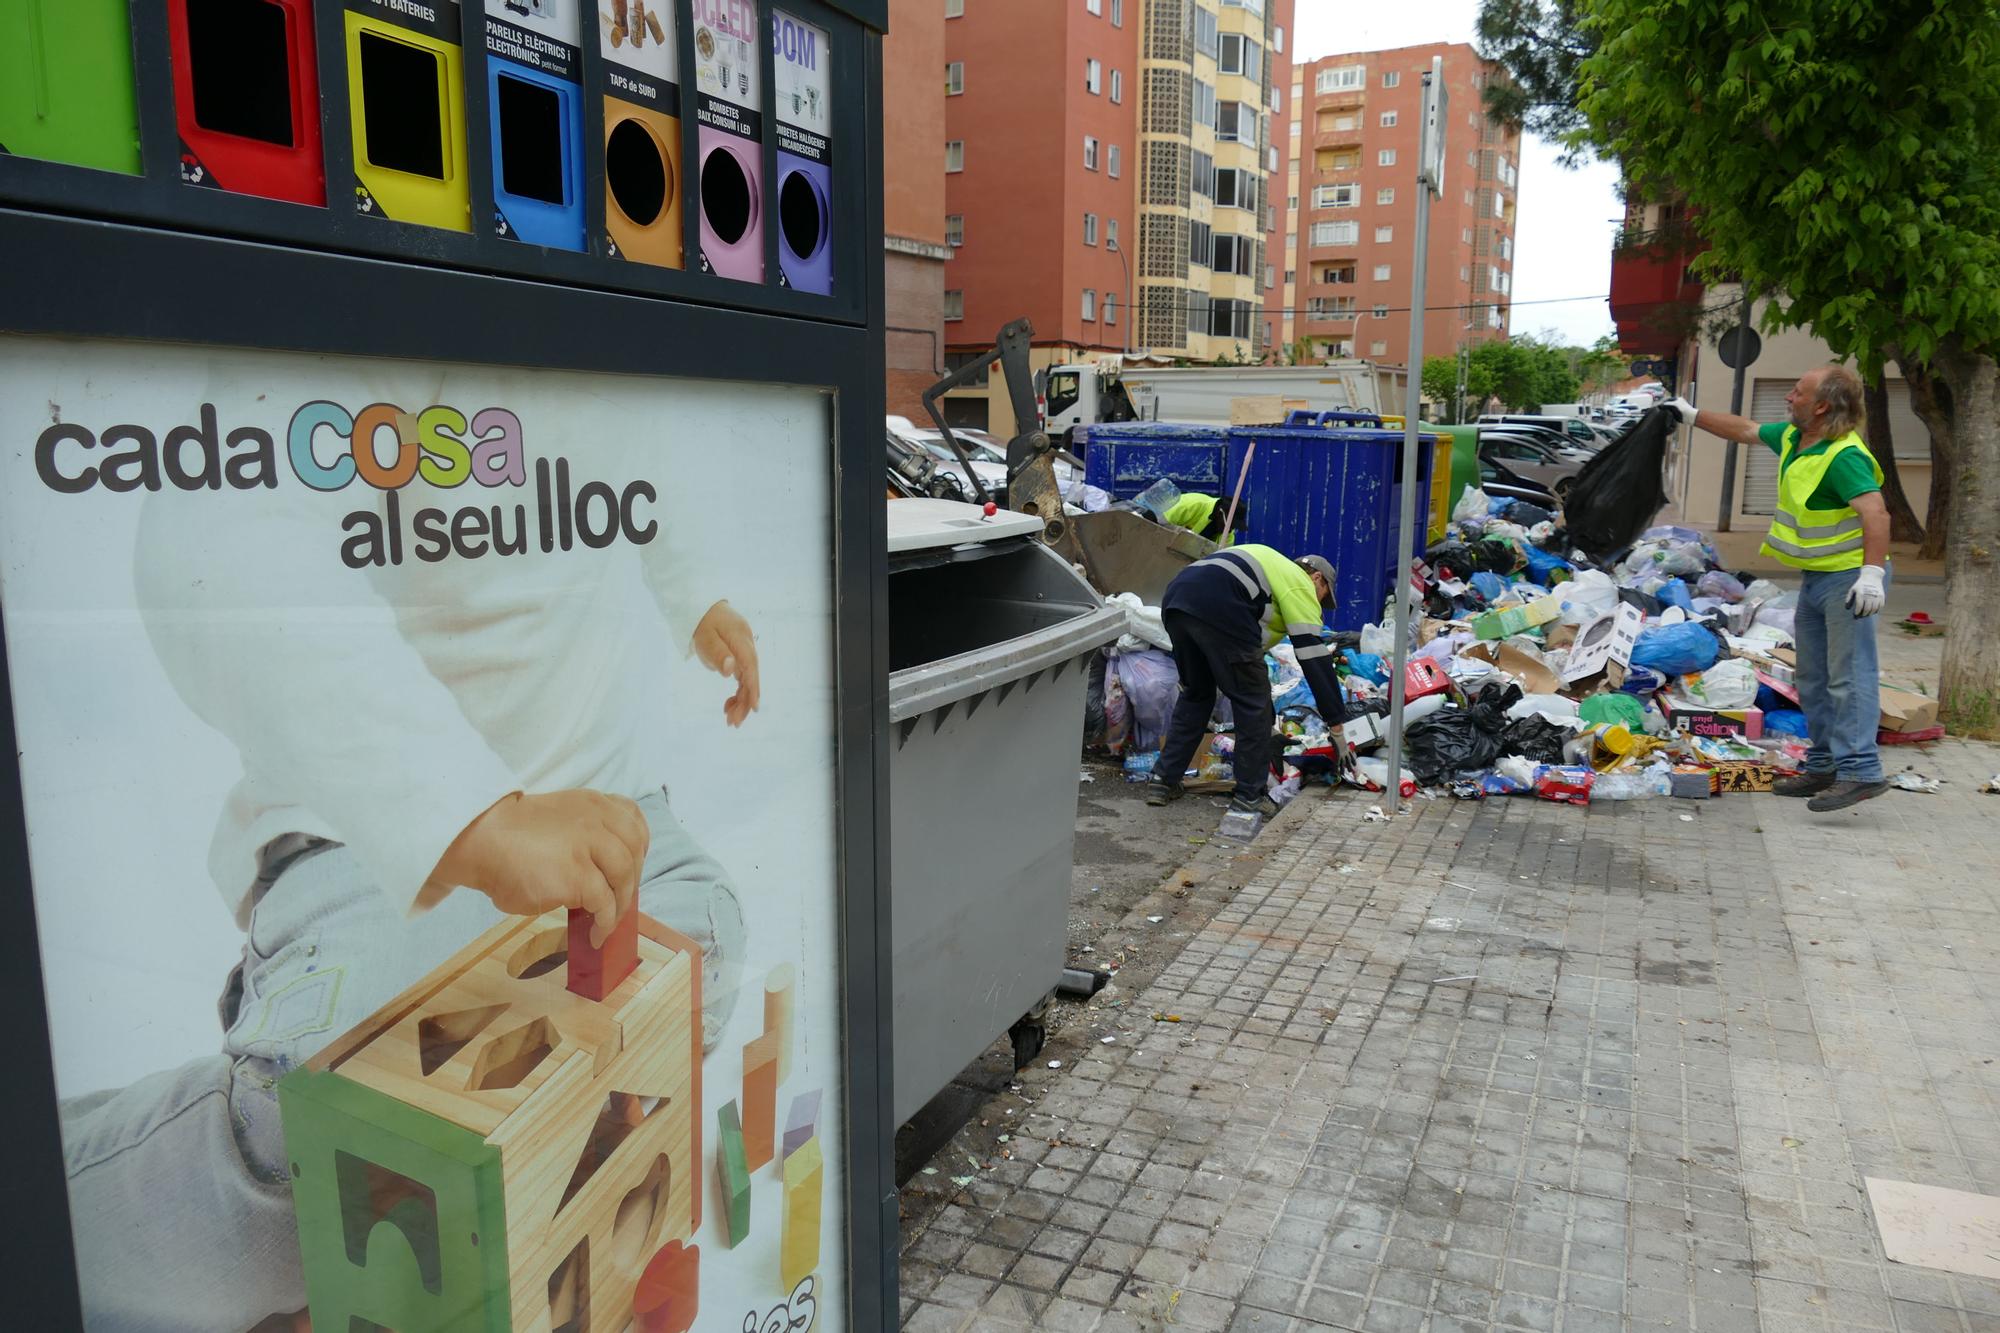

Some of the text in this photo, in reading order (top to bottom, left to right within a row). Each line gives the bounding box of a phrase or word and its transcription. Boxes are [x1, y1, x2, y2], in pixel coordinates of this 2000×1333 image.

[390, 0, 435, 22] BATERIES
[486, 20, 522, 44] PARELLS
[524, 35, 566, 60] ELÈCTRICS
[486, 36, 567, 75] ELECTRÒNICS petit format
[610, 72, 656, 99] TAPS de SURO
[708, 100, 739, 119] BOMBETES
[712, 114, 737, 131] CONSUM
[740, 123, 751, 135] LED
[781, 137, 820, 158] INCANDESCENTS
[34, 399, 527, 494] cada cosa
[340, 456, 659, 569] al seu lloc
